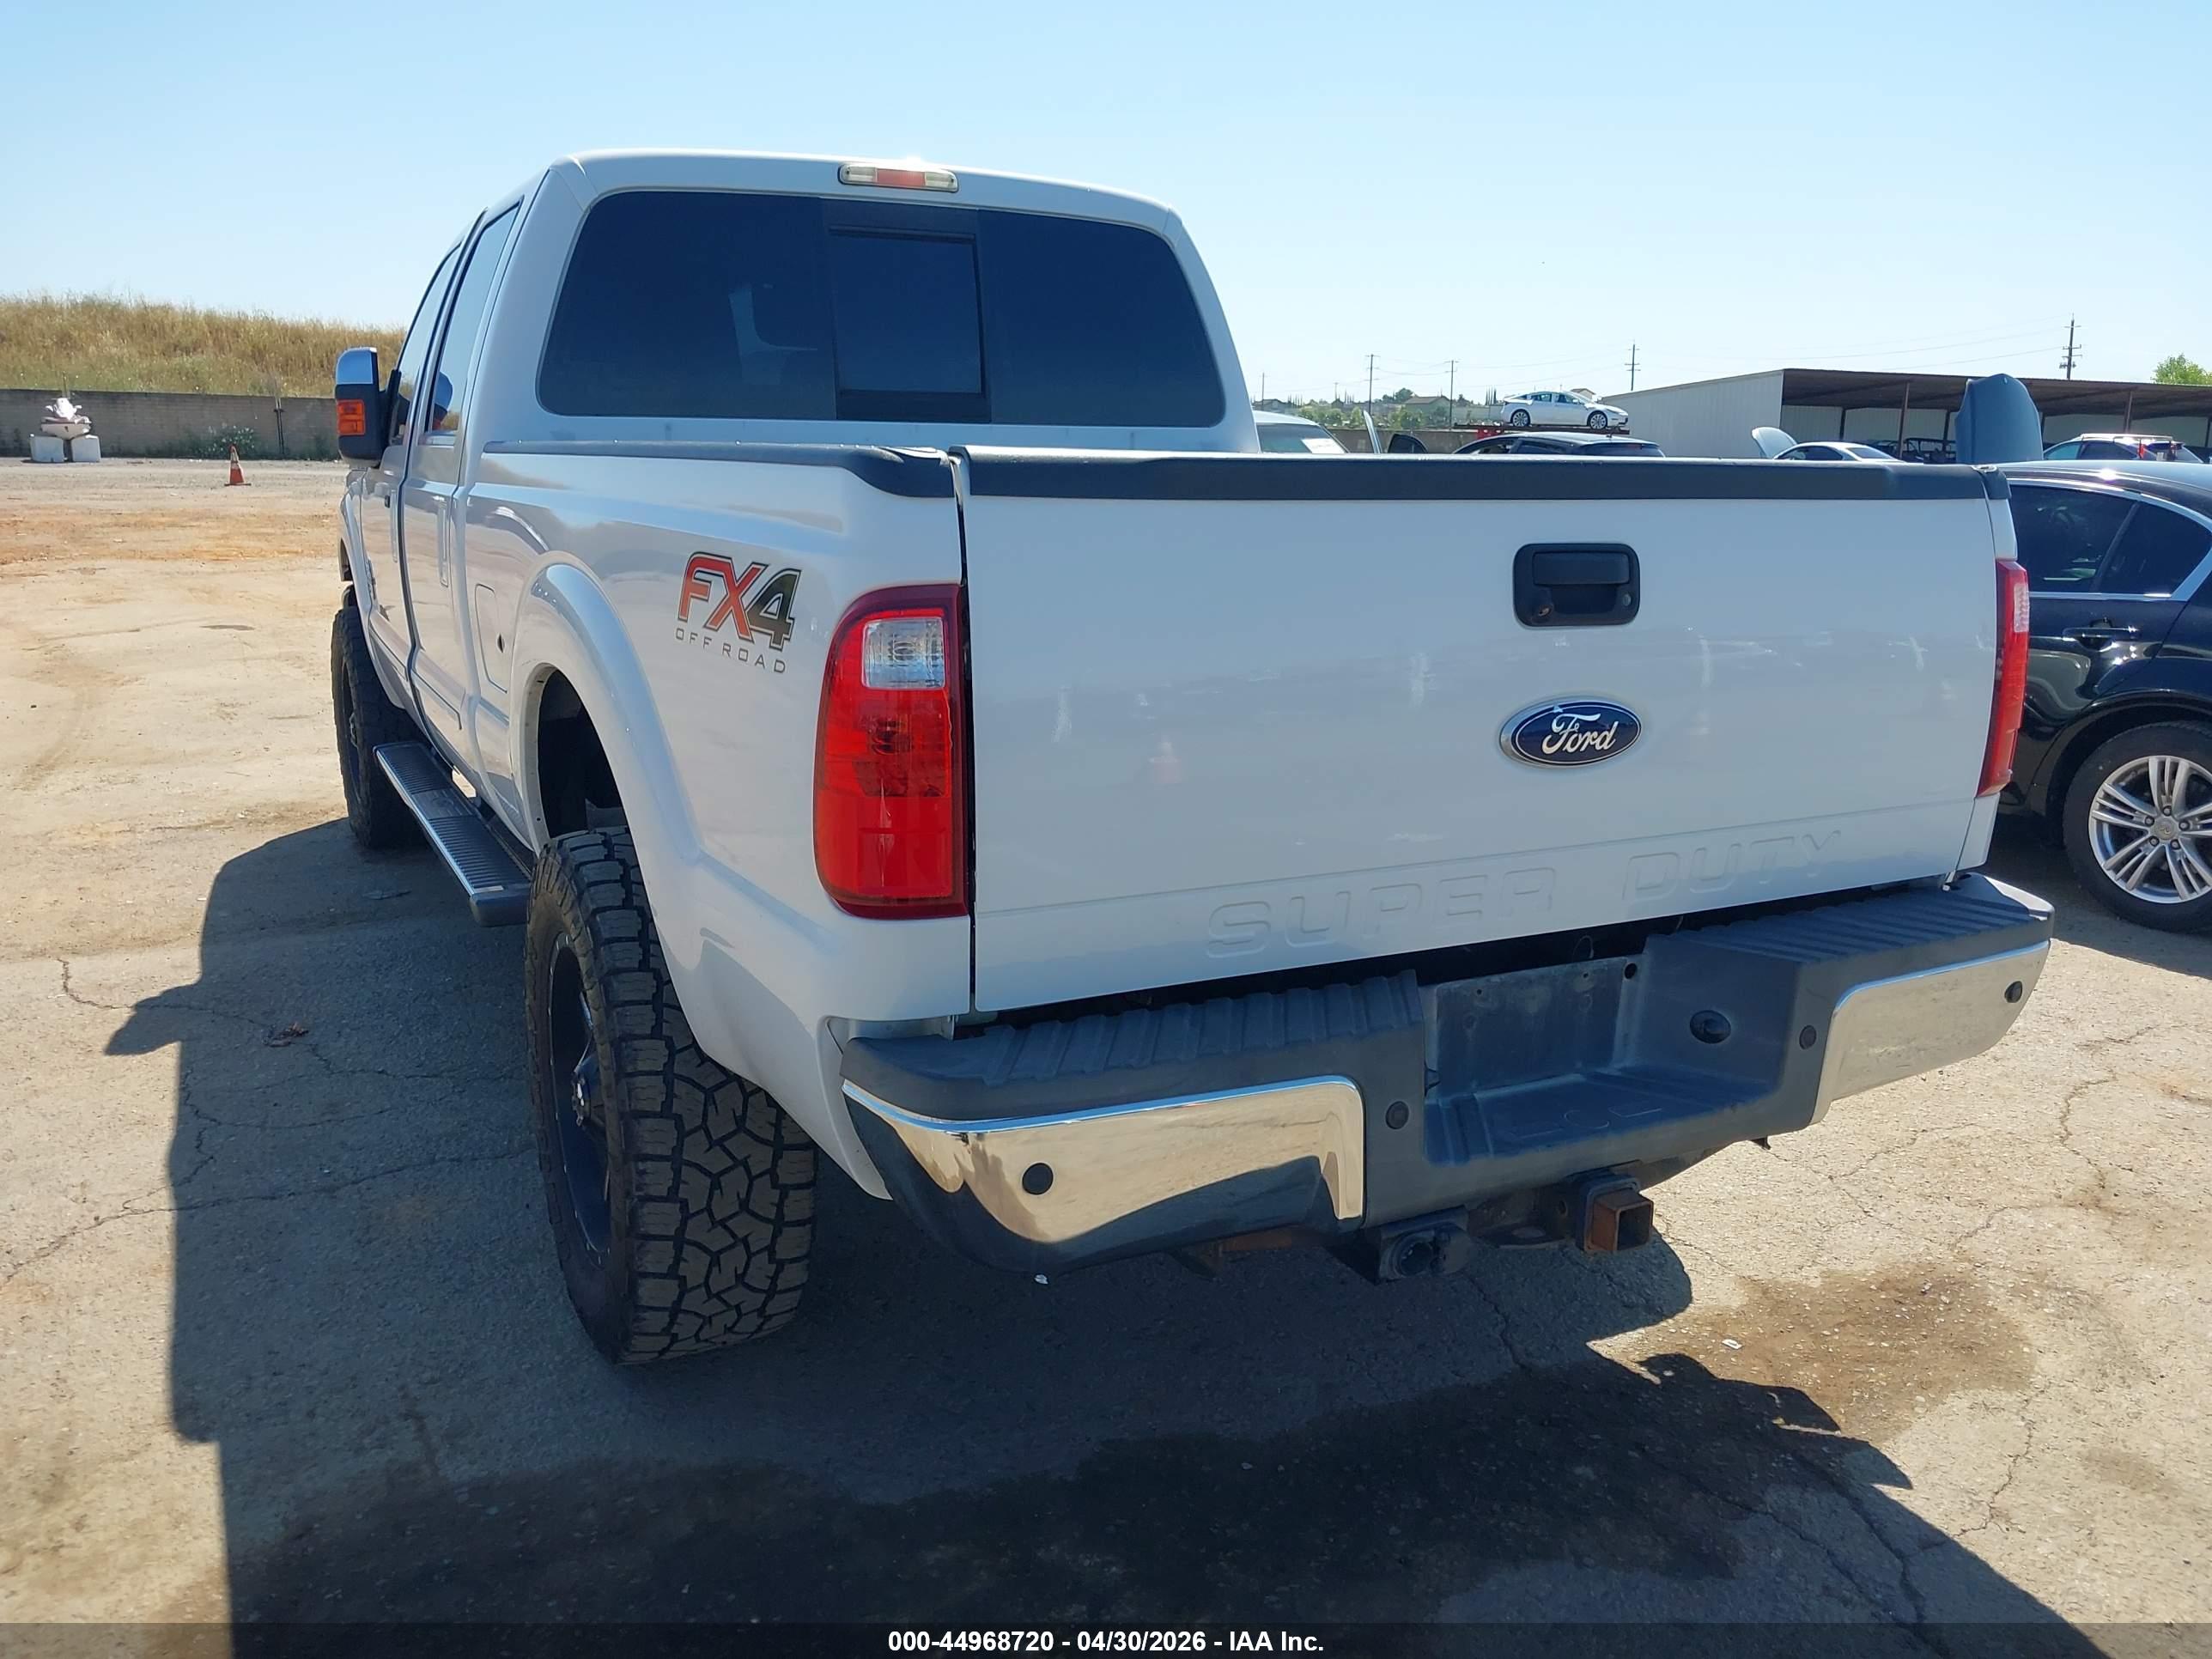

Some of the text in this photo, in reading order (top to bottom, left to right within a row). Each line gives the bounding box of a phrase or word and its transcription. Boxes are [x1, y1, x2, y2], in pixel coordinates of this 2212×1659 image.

[677, 551, 802, 652] FX4
[676, 628, 786, 673] OFF ROAD
[1541, 713, 1619, 755] Ford
[1206, 830, 1841, 958] SUPER DUTY
